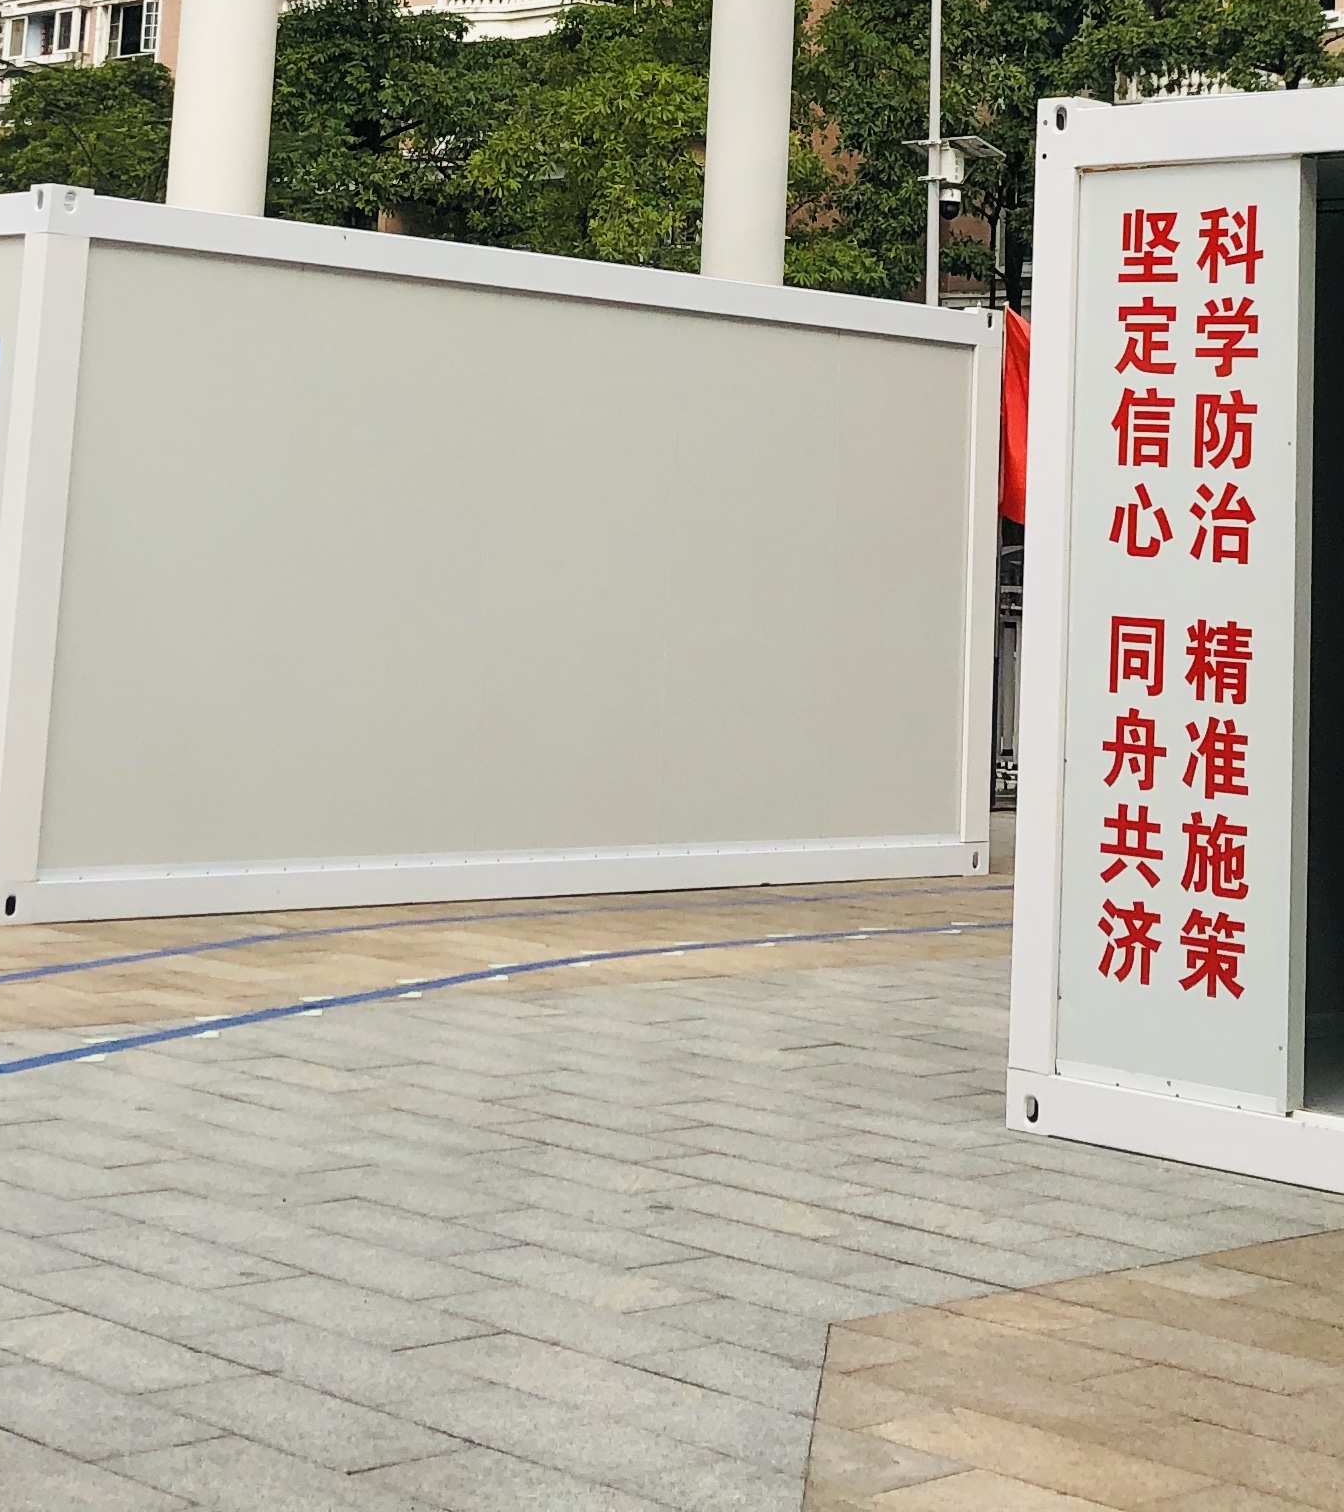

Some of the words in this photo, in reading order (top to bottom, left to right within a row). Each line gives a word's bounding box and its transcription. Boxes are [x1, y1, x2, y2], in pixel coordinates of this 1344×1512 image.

[1109, 208, 1180, 558] 坚定信心
[1189, 204, 1265, 565] 科学防治
[1098, 615, 1167, 985] 同舟共济
[1179, 619, 1253, 998] 精准施策
